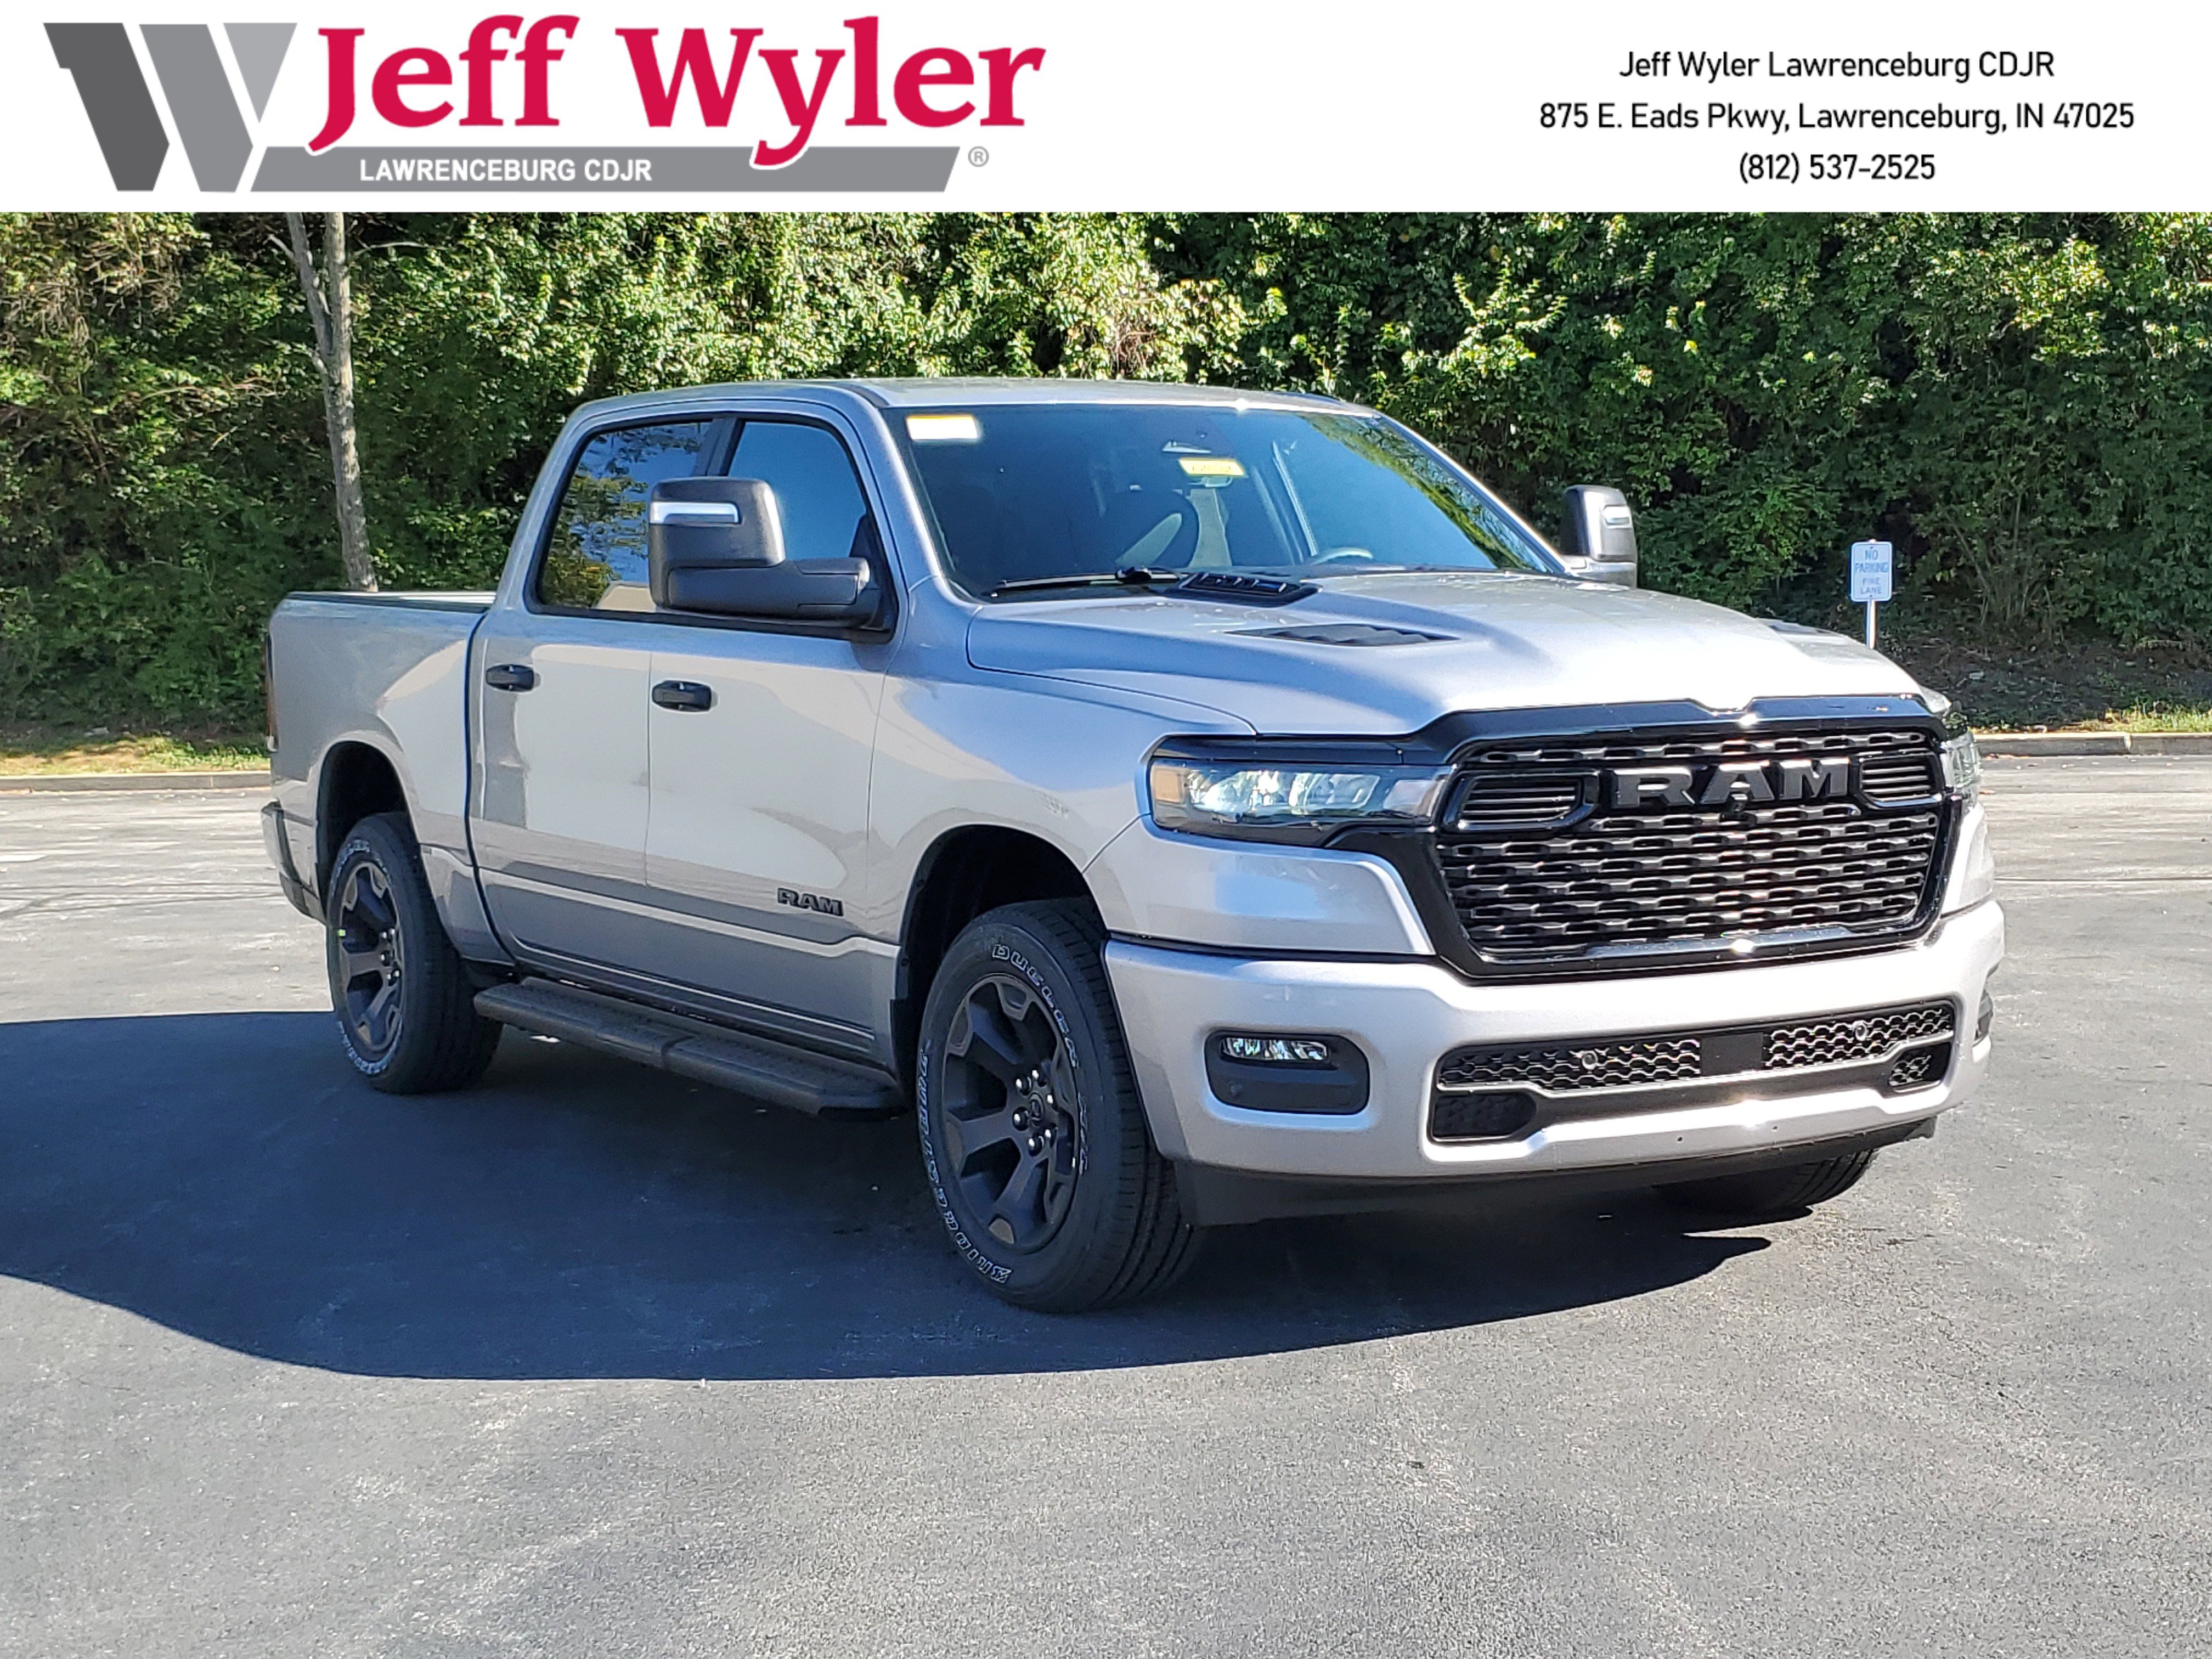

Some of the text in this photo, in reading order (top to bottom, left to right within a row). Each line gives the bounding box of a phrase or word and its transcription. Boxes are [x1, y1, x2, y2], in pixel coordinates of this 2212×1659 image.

[1865, 550, 1878, 560] NO
[1855, 562, 1888, 573] PARKING
[1611, 757, 1850, 809] RAM
[777, 887, 844, 917] RAM
